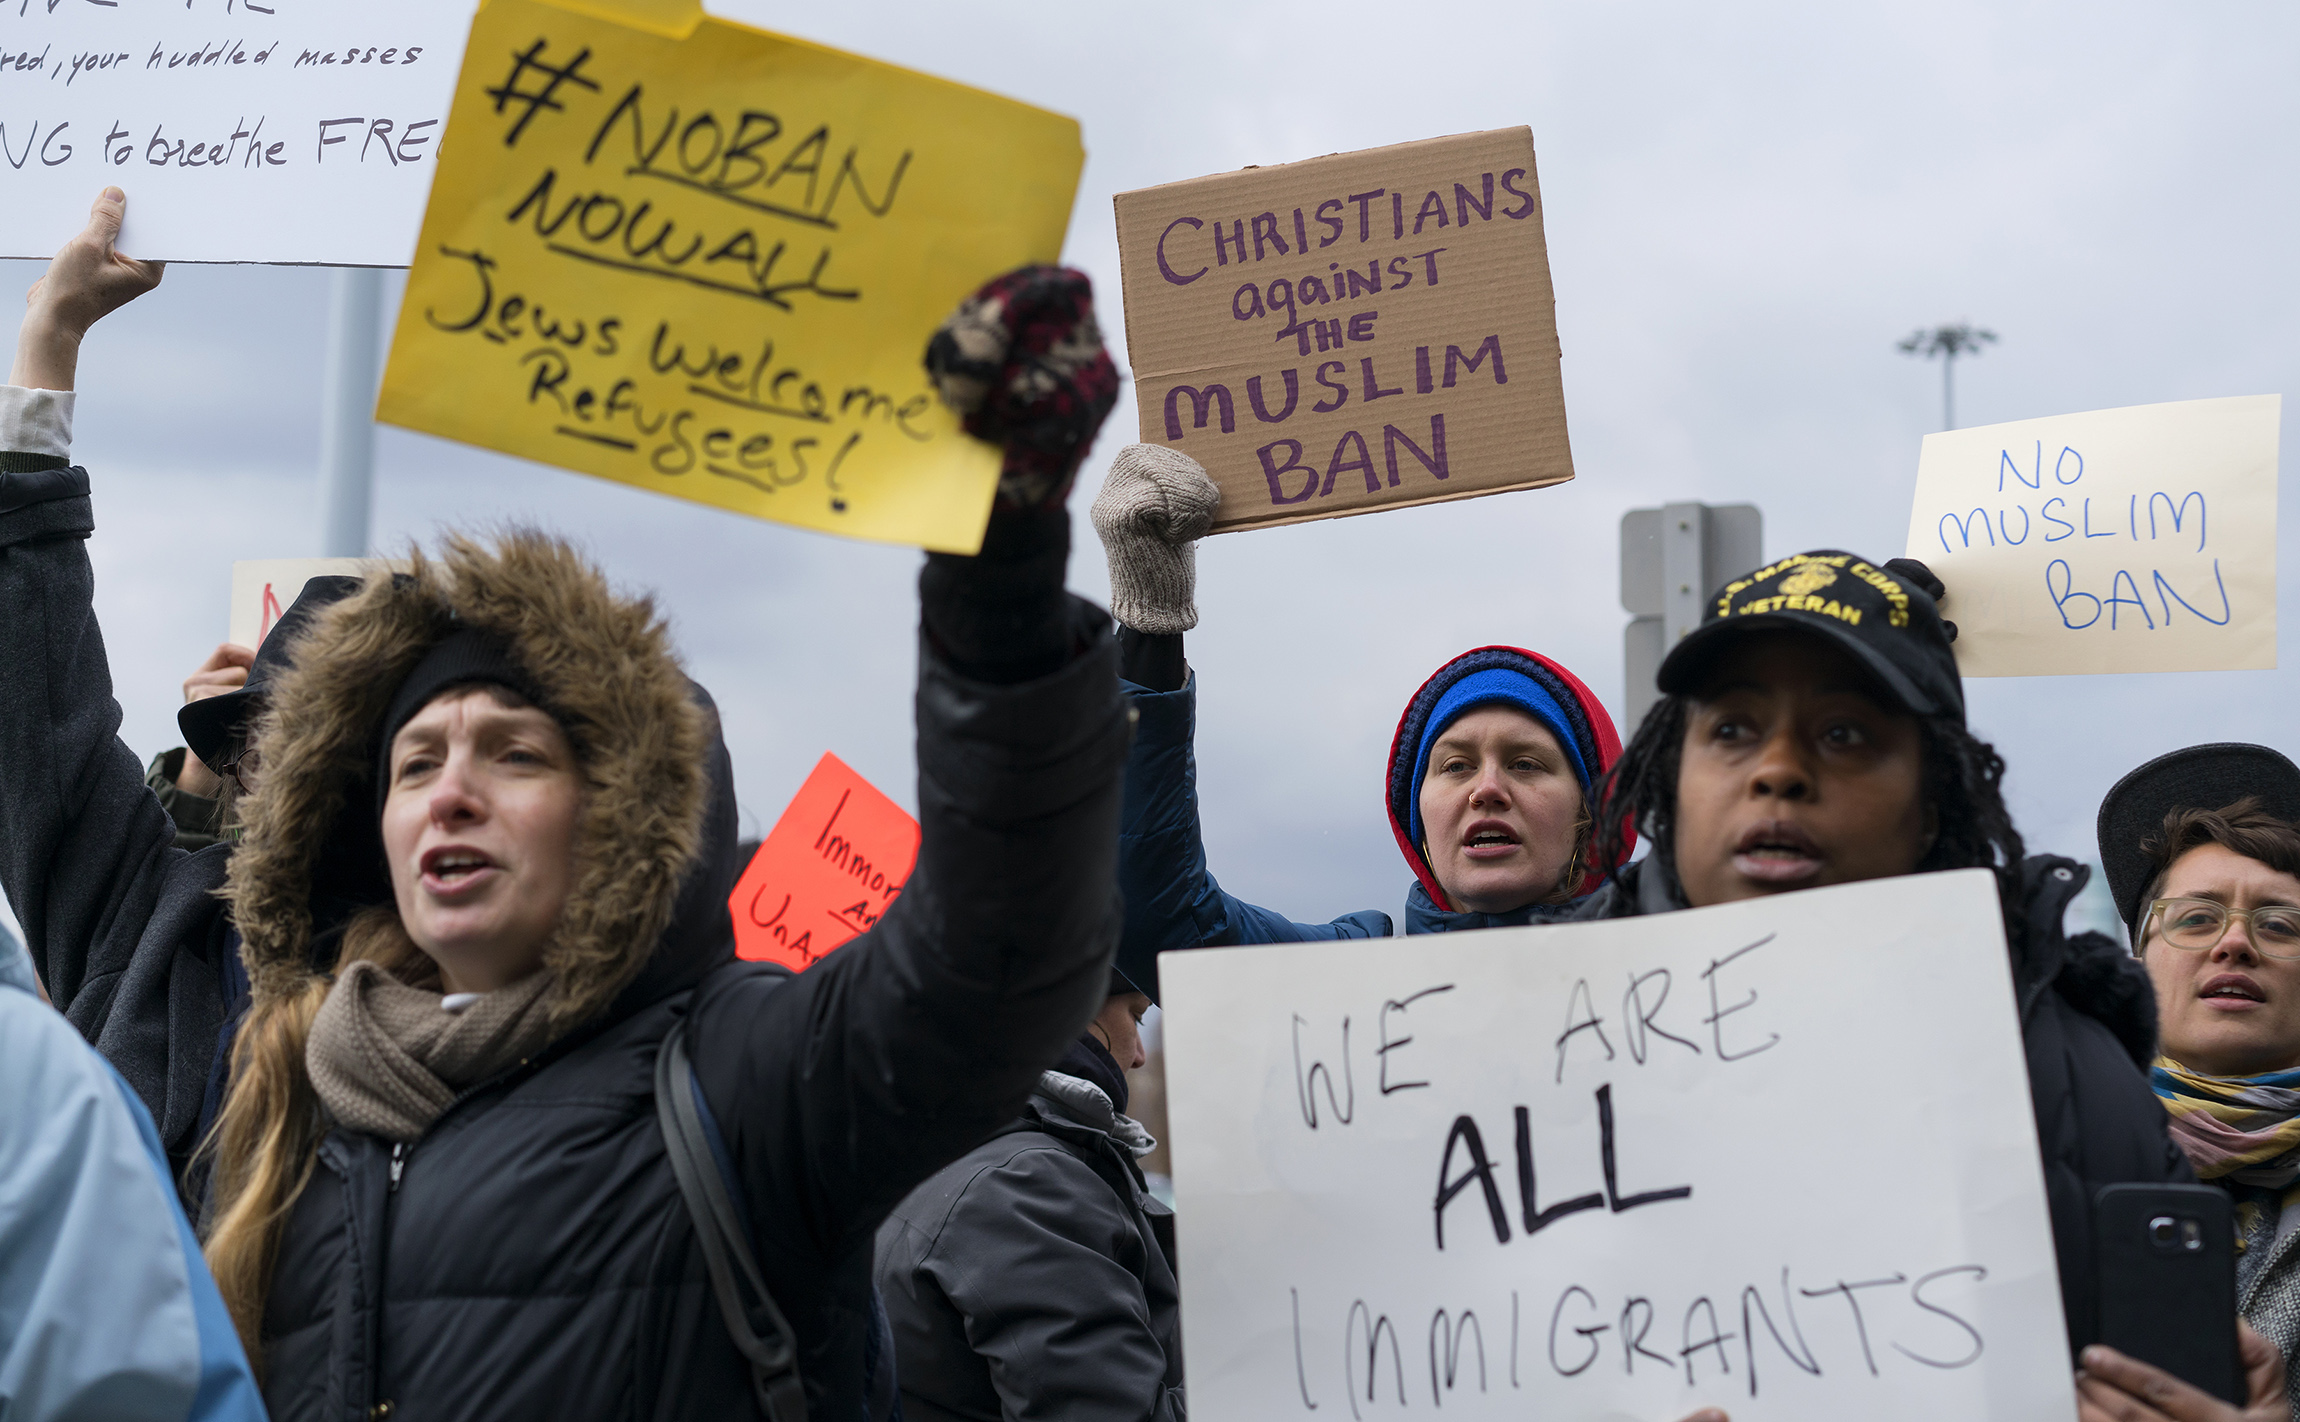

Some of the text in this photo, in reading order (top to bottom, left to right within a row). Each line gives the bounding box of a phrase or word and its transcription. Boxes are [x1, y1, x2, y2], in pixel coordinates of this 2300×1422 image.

[0, 43, 63, 81] red,
[146, 38, 279, 69] huddled
[294, 41, 423, 69] masses
[105, 119, 133, 165] to
[146, 115, 287, 168] breathe
[318, 117, 446, 167] FRE
[1156, 167, 1535, 286] CHRISTIANS
[425, 243, 622, 358] Jews
[1294, 310, 1379, 357] THE
[519, 346, 862, 513] Refugees!
[1163, 334, 1509, 441] MUSLIM
[1256, 413, 1450, 506] BAN
[1998, 439, 2084, 493] NO
[1938, 490, 2206, 554] MUSLIM
[1738, 593, 1863, 627] VETERAN
[1849, 561, 1910, 628] CORPS
[2045, 558, 2231, 631] BAN
[814, 787, 903, 900] Immor
[1292, 932, 1781, 1131] WE ARE
[1434, 1083, 1693, 1251] ALL
[1290, 1265, 1990, 1421] IMMIGRANTS
